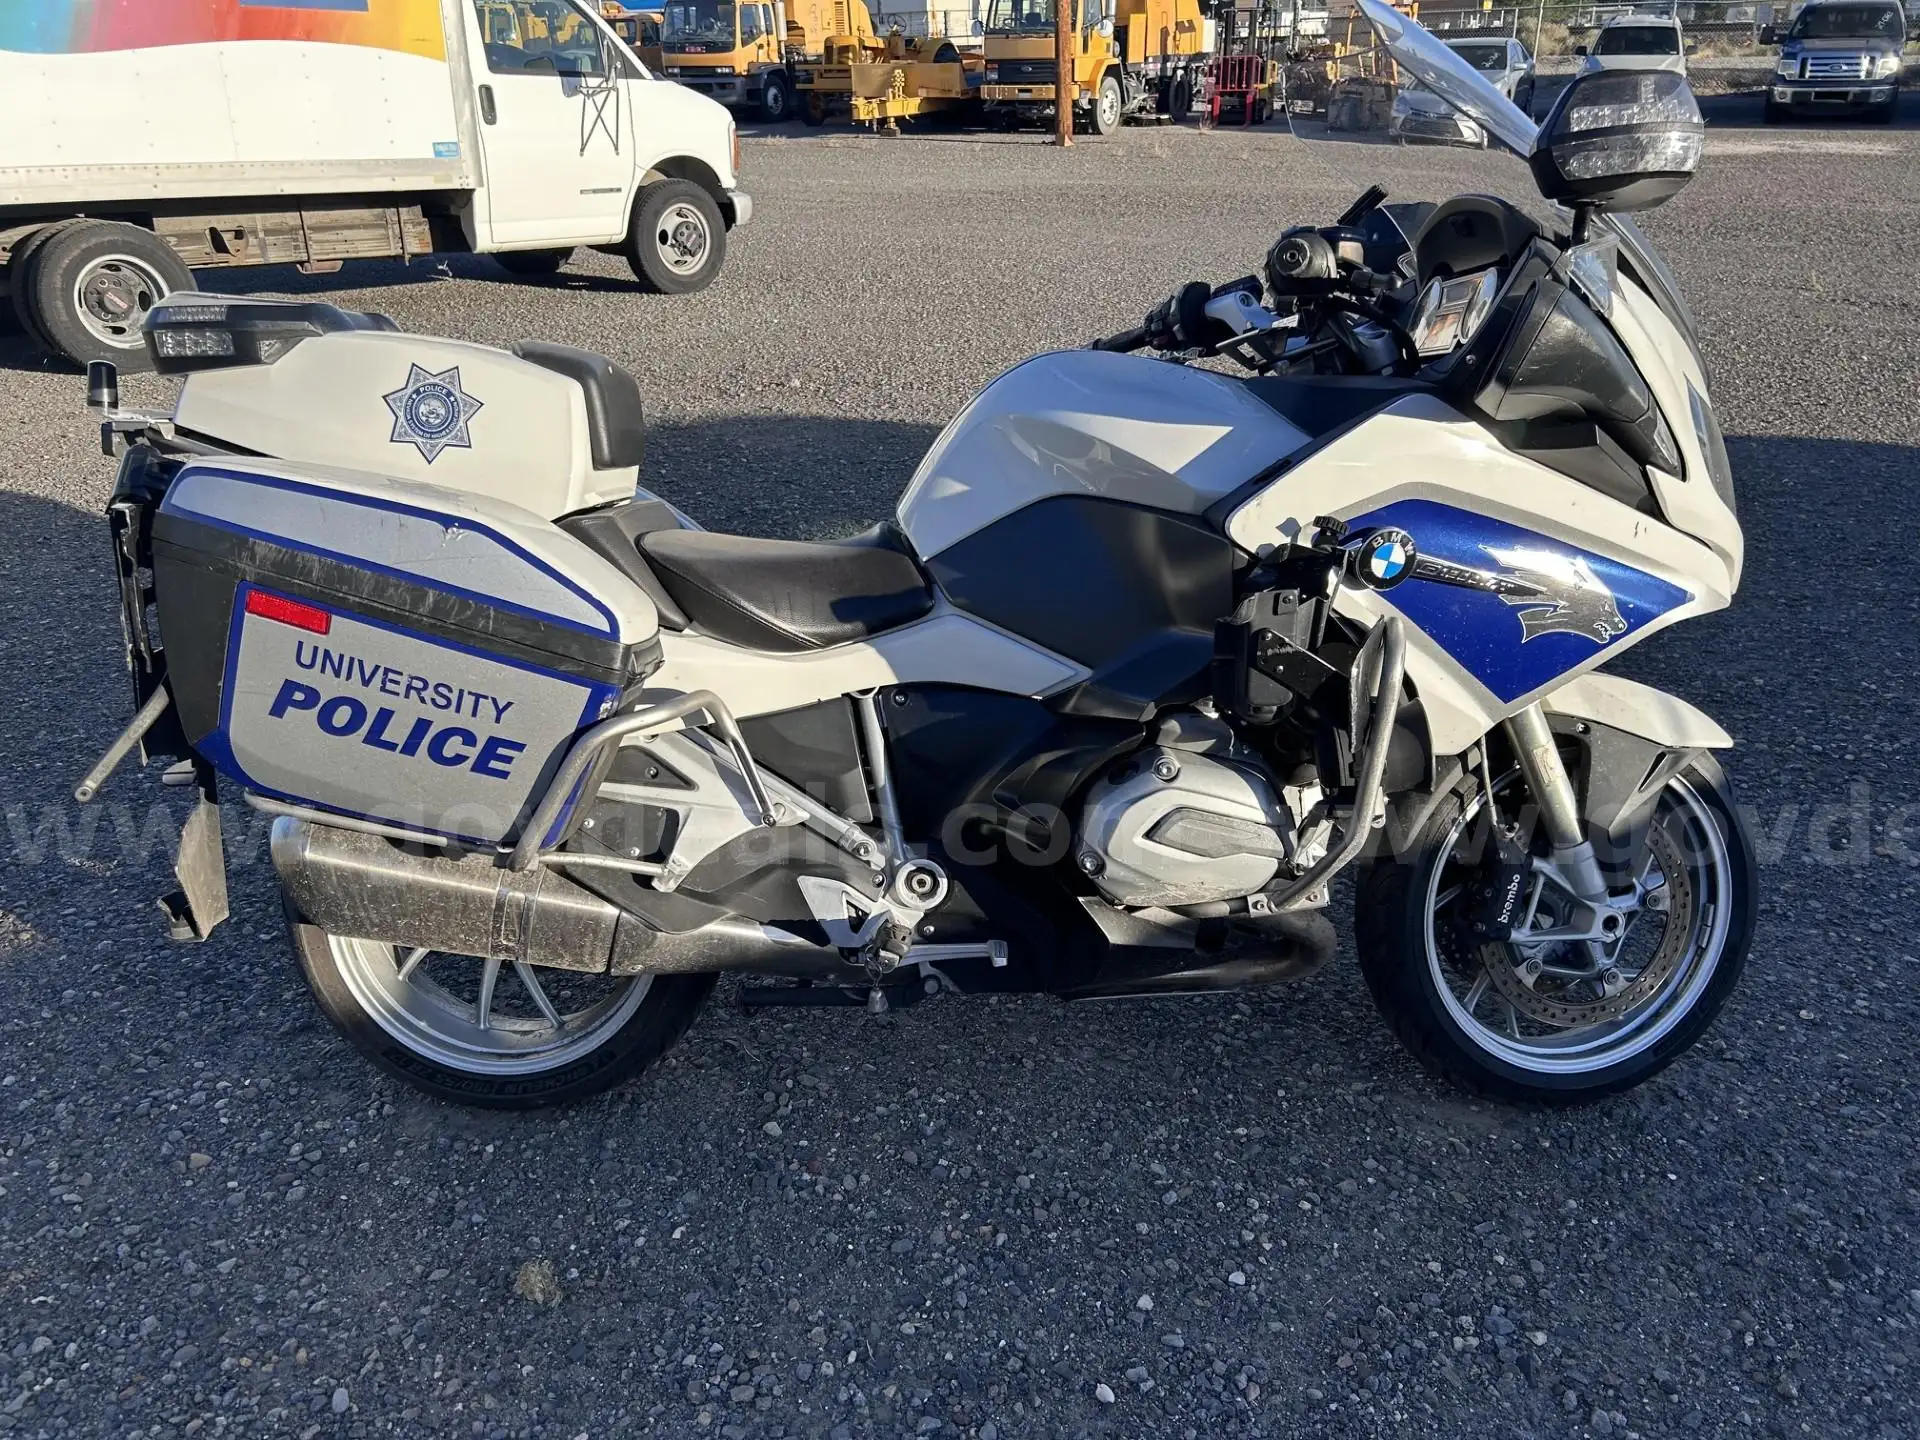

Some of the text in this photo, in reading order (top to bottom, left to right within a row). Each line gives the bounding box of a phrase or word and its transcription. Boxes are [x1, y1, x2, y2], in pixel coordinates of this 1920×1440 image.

[419, 385, 449, 394] POLICE
[1371, 532, 1415, 556] BMW
[295, 641, 514, 724] UNIVERSITY
[268, 679, 527, 780] POLICE
[1497, 874, 1520, 923] brembo
